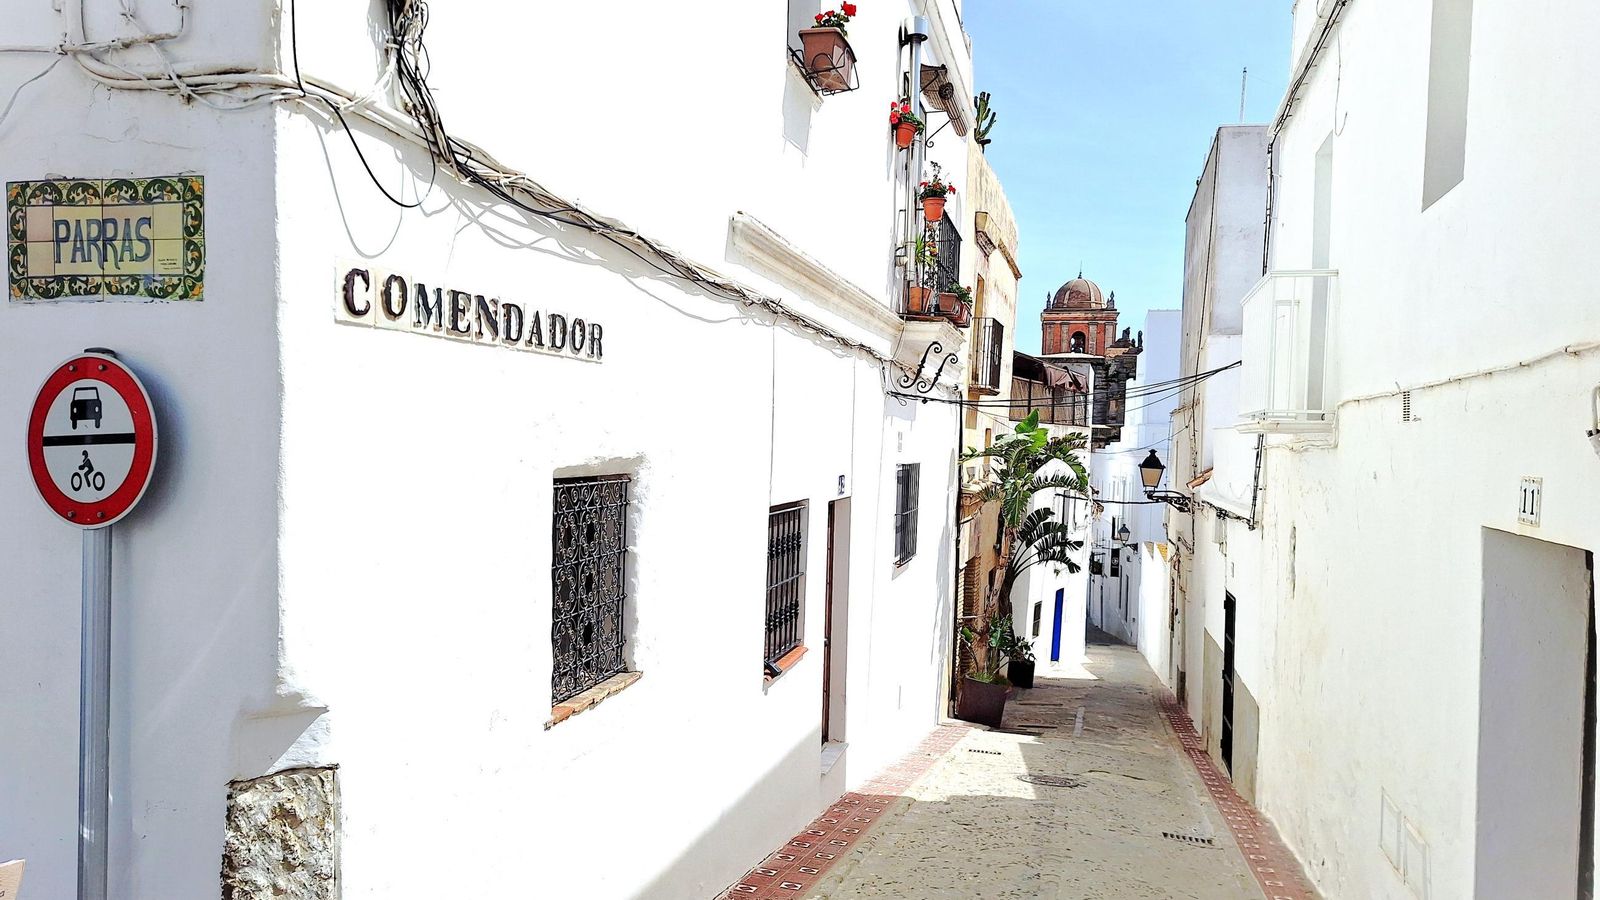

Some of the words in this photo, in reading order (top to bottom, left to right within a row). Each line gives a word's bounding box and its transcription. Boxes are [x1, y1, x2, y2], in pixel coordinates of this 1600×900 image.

[54, 216, 152, 270] PARRAS
[343, 267, 604, 359] COMENDADOR
[1521, 487, 1535, 515] 11
